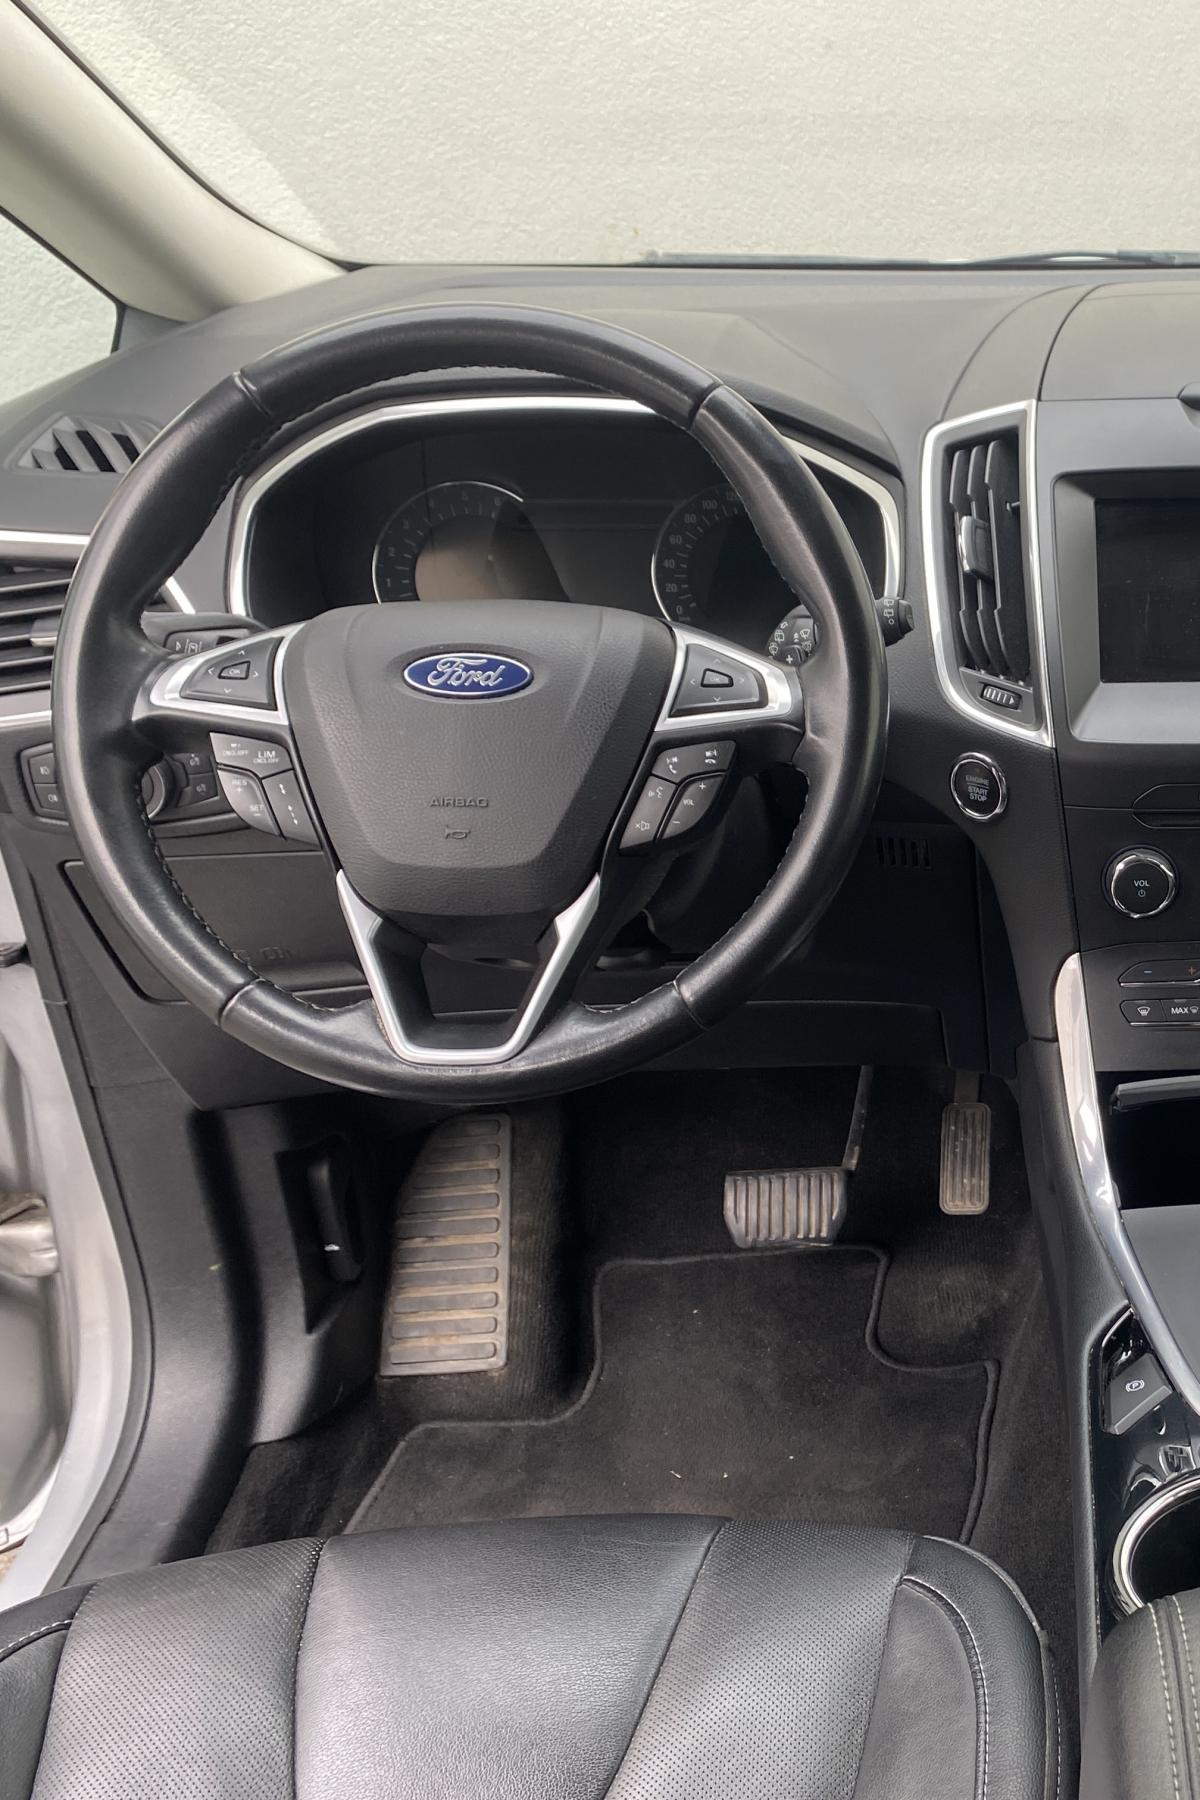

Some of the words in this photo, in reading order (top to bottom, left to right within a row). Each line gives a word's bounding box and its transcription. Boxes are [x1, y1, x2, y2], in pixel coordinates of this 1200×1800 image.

[702, 500, 718, 510] 100
[388, 547, 396, 557] 2
[663, 558, 675, 569] 40
[665, 582, 678, 593] 20
[676, 605, 683, 615] 0
[229, 668, 240, 676] OK
[427, 657, 506, 687] Ford
[257, 750, 276, 758] LIM
[968, 786, 988, 796] START
[970, 793, 987, 801] STOP
[430, 797, 489, 808] AIRBAG
[1133, 879, 1151, 887] VOL
[1171, 1006, 1189, 1014] MAX
